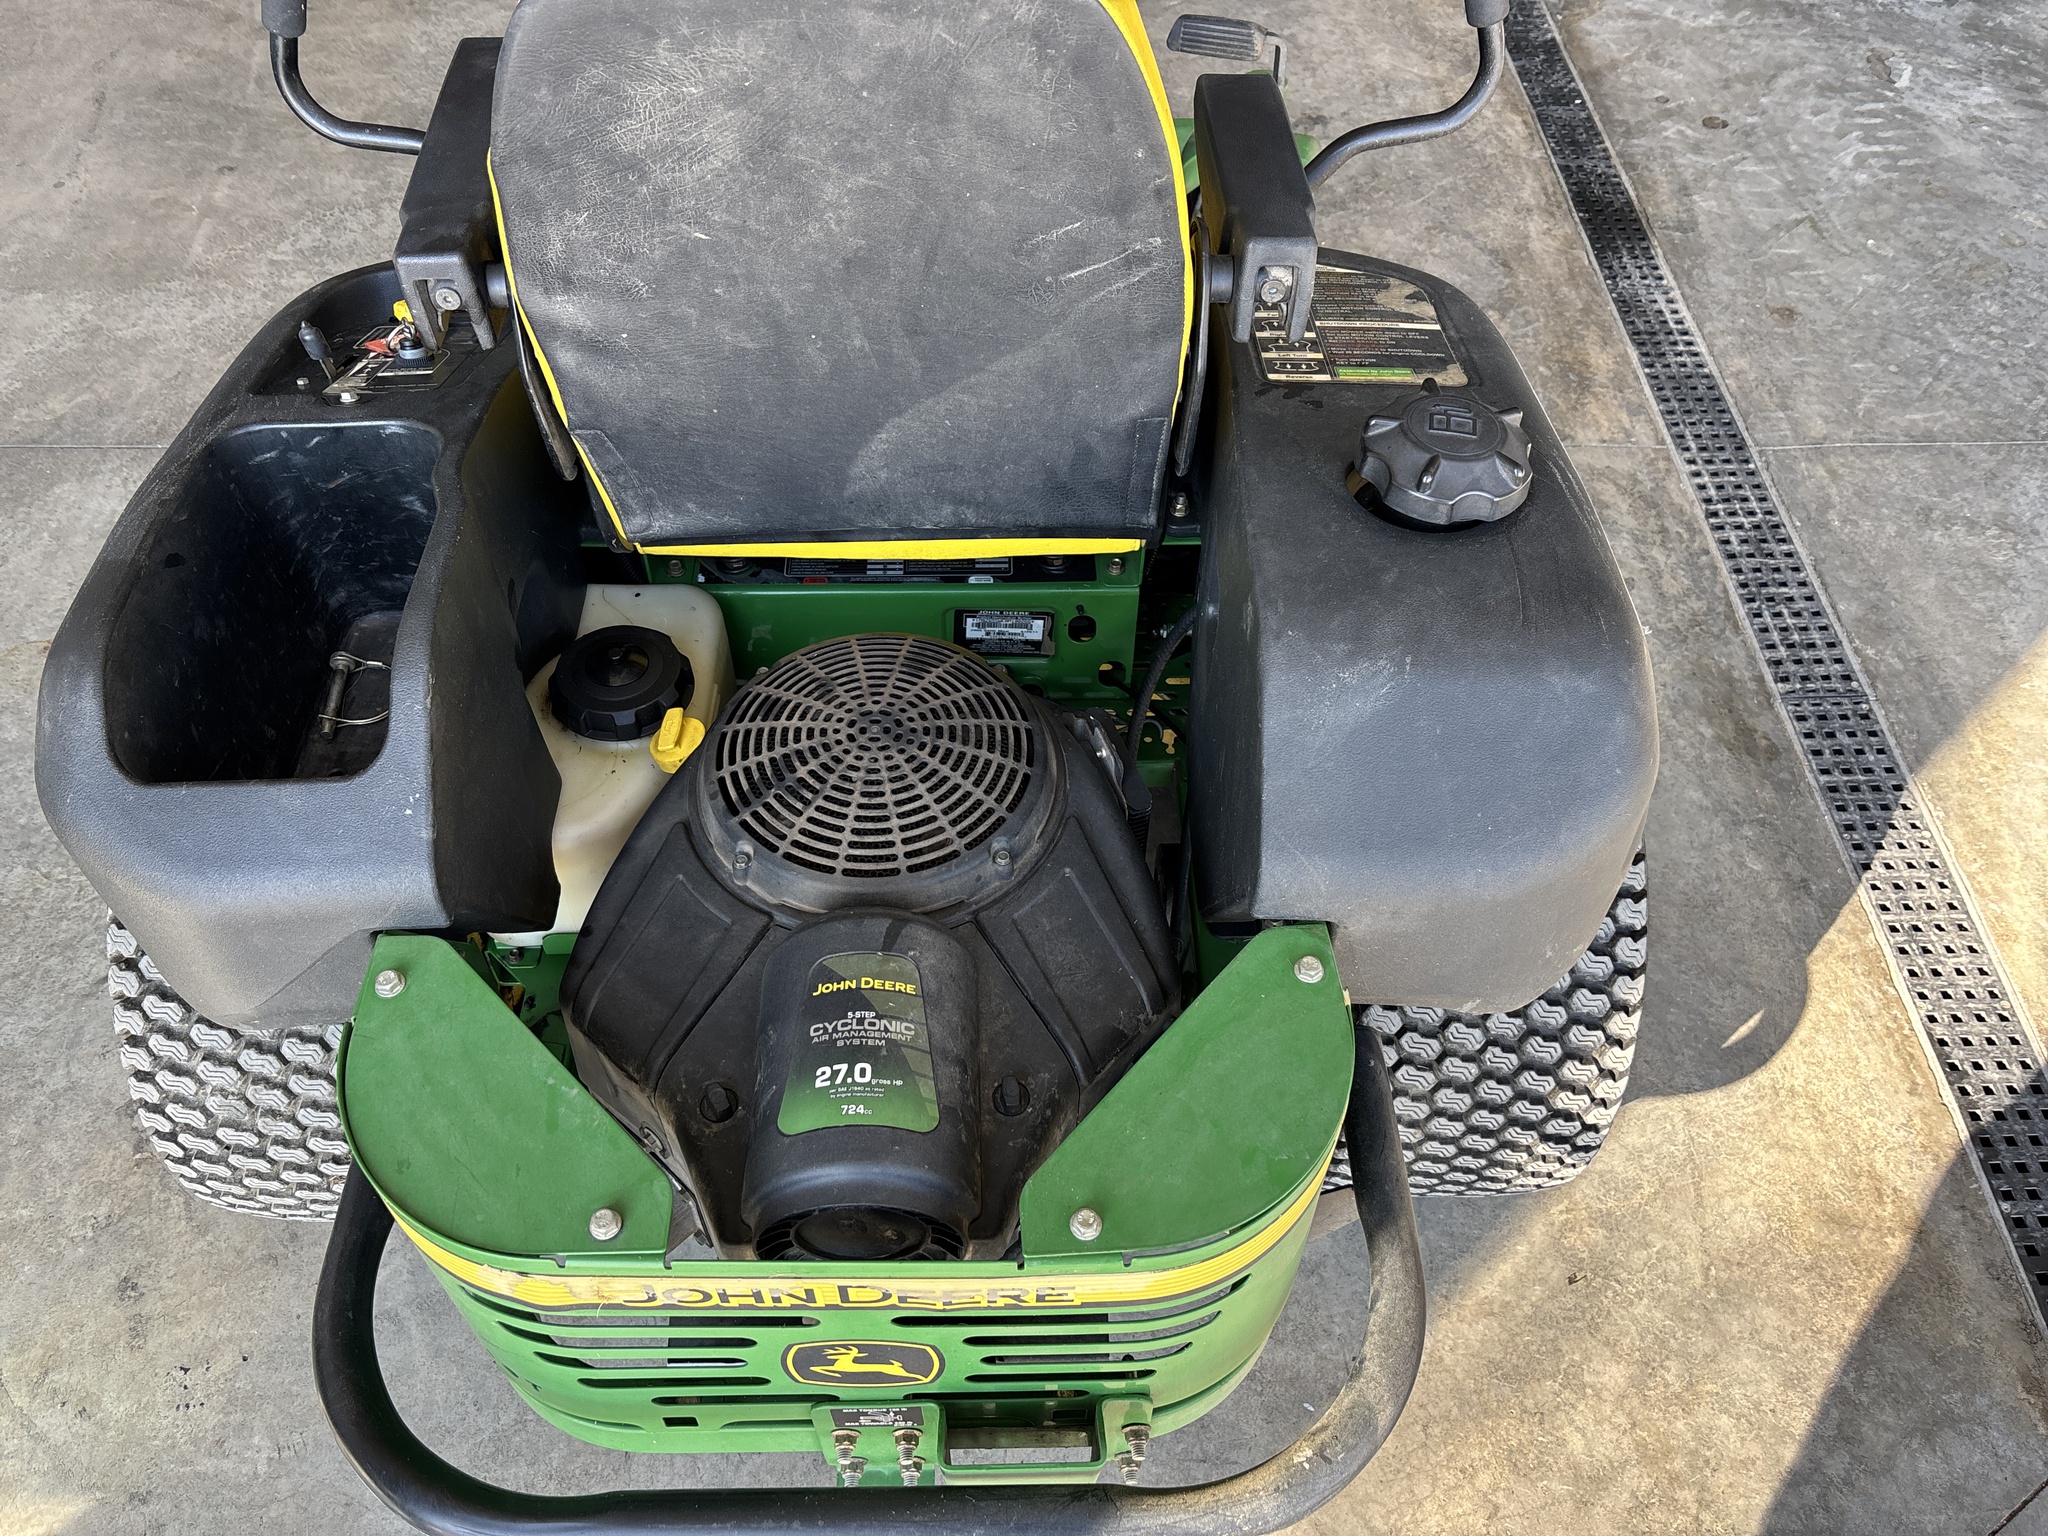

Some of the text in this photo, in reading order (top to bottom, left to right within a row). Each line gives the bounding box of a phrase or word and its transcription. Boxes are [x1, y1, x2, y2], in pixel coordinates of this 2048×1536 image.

[812, 977, 917, 997] JOHN DEERE
[809, 1018, 916, 1037] CYCLONIC
[811, 1030, 912, 1044] AIR MANAGEMENT
[836, 1038, 886, 1047] SYSTEM
[814, 1062, 872, 1089] 27.0
[623, 1284, 1082, 1308] JOHN DEERE
